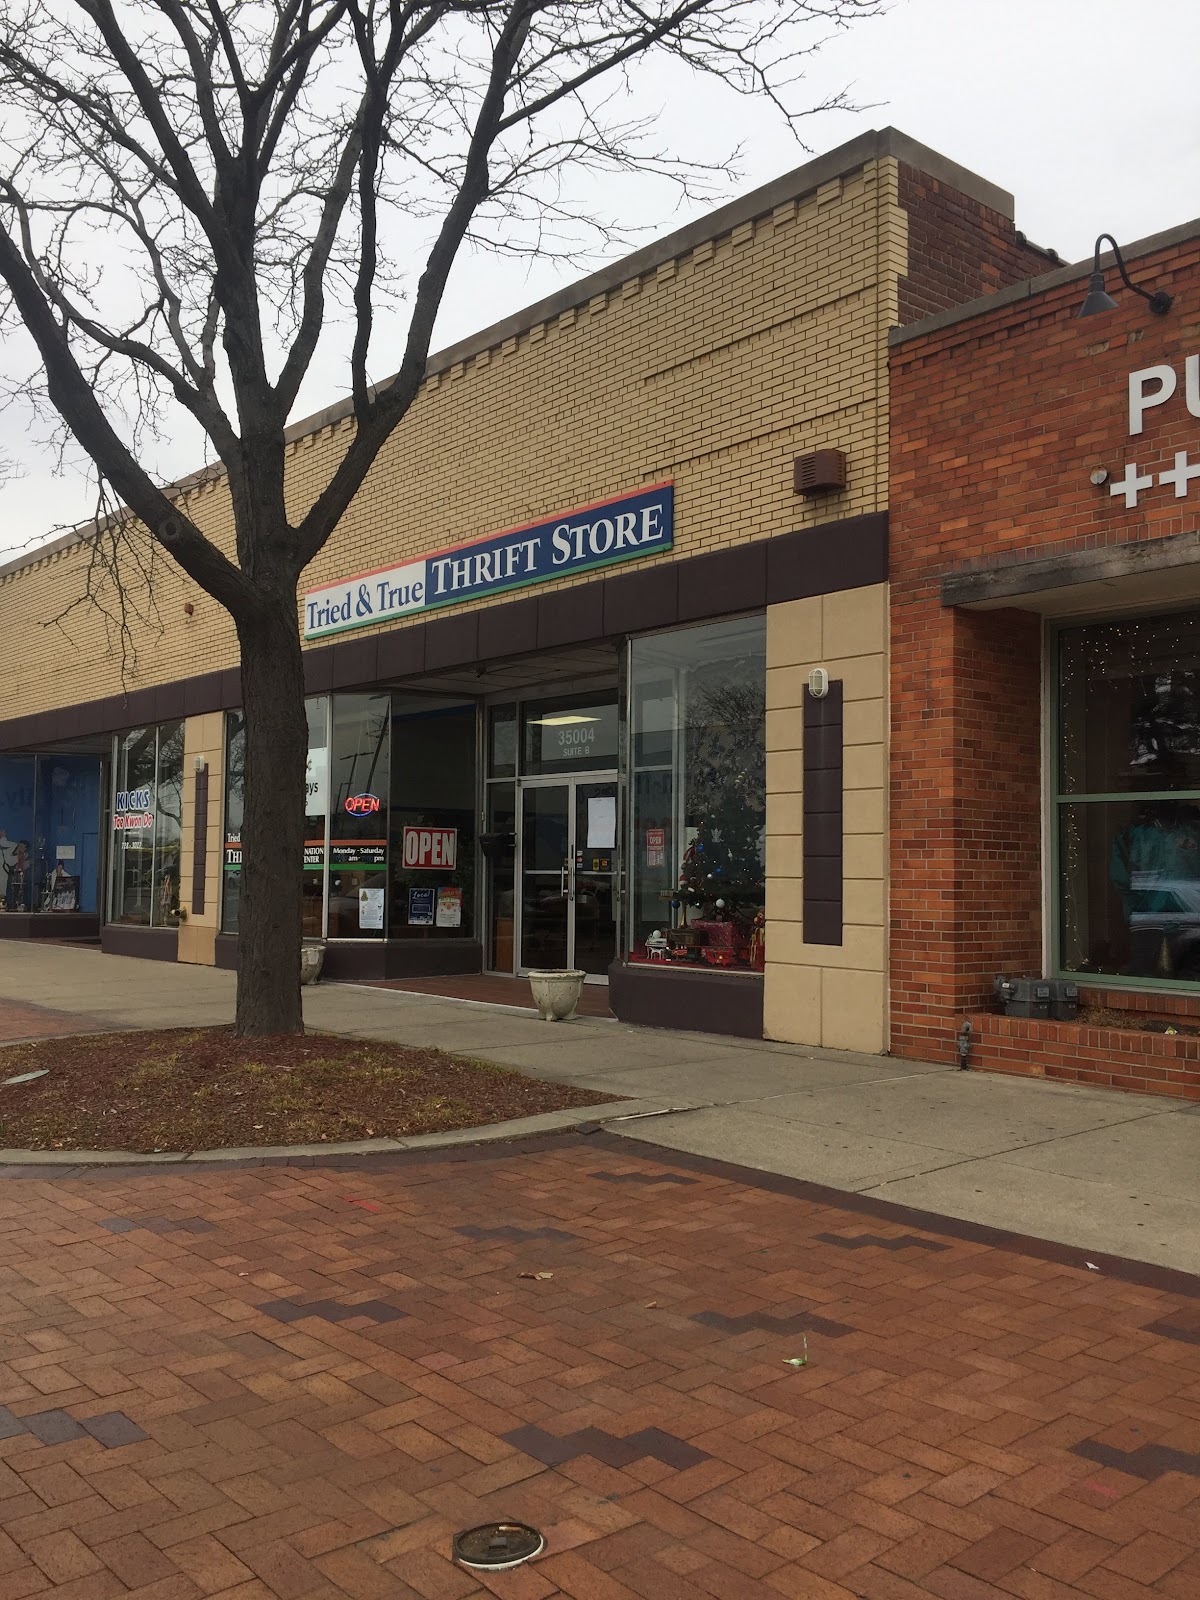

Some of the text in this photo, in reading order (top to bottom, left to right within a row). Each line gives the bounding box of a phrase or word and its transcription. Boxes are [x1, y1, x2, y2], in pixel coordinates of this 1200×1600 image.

[306, 504, 664, 630] Tried & True THRIFT STORE
[558, 728, 595, 745] 35004
[563, 747, 582, 756] SUITE
[116, 790, 150, 811] KICKS
[345, 797, 380, 811] OPEN
[124, 813, 142, 829] Kwon
[143, 811, 153, 828] Do
[304, 847, 324, 855] NATION
[333, 847, 356, 855] Monday
[405, 831, 455, 865] OPEN
[303, 855, 319, 863] ENTER
[373, 855, 384, 863] pm
